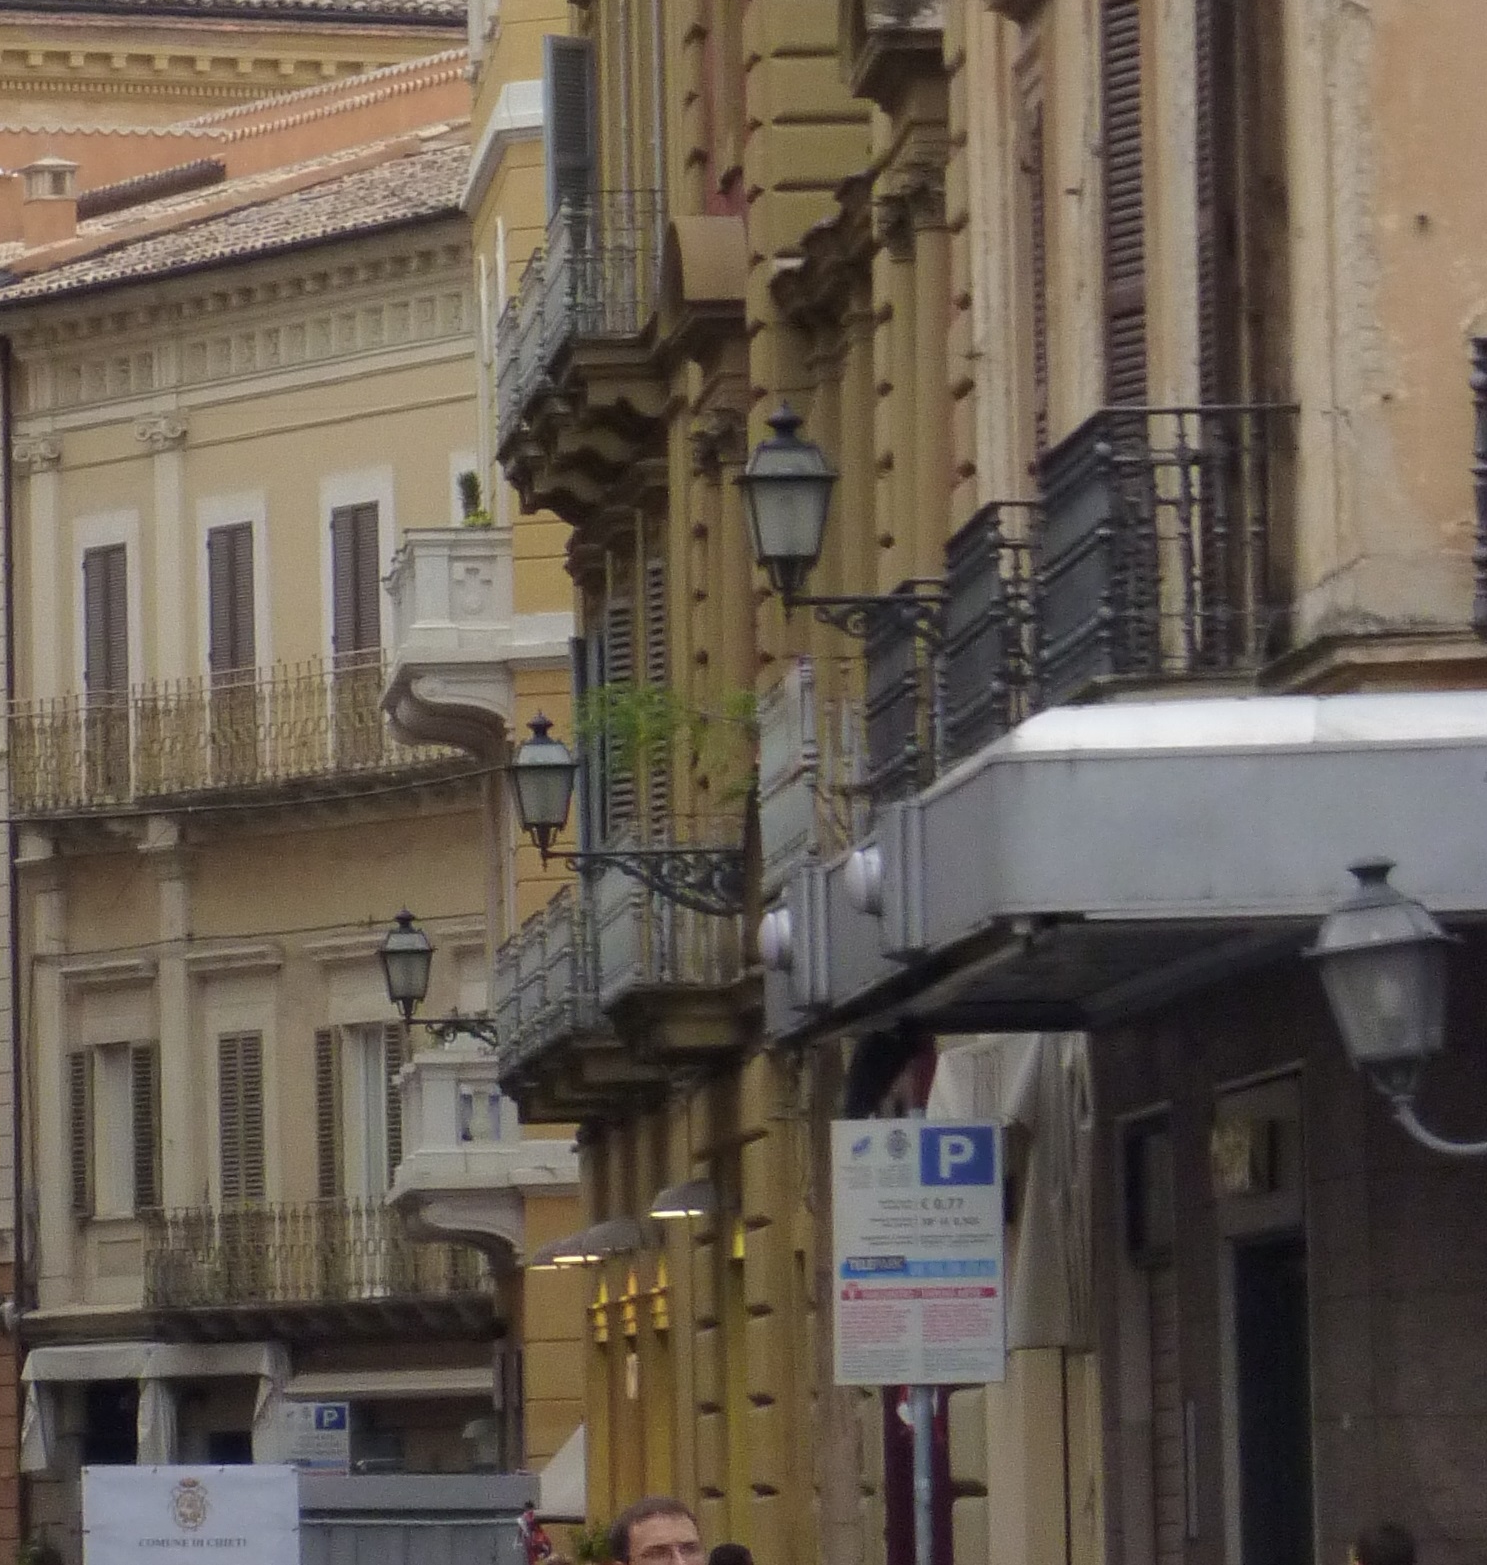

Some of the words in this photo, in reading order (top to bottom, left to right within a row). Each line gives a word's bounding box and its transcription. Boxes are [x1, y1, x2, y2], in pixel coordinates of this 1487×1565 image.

[939, 1135, 975, 1179] P
[323, 1409, 339, 1428] P
[138, 1537, 190, 1548] COMUNE
[192, 1537, 204, 1547] DI
[206, 1537, 247, 1547] CHIETI
